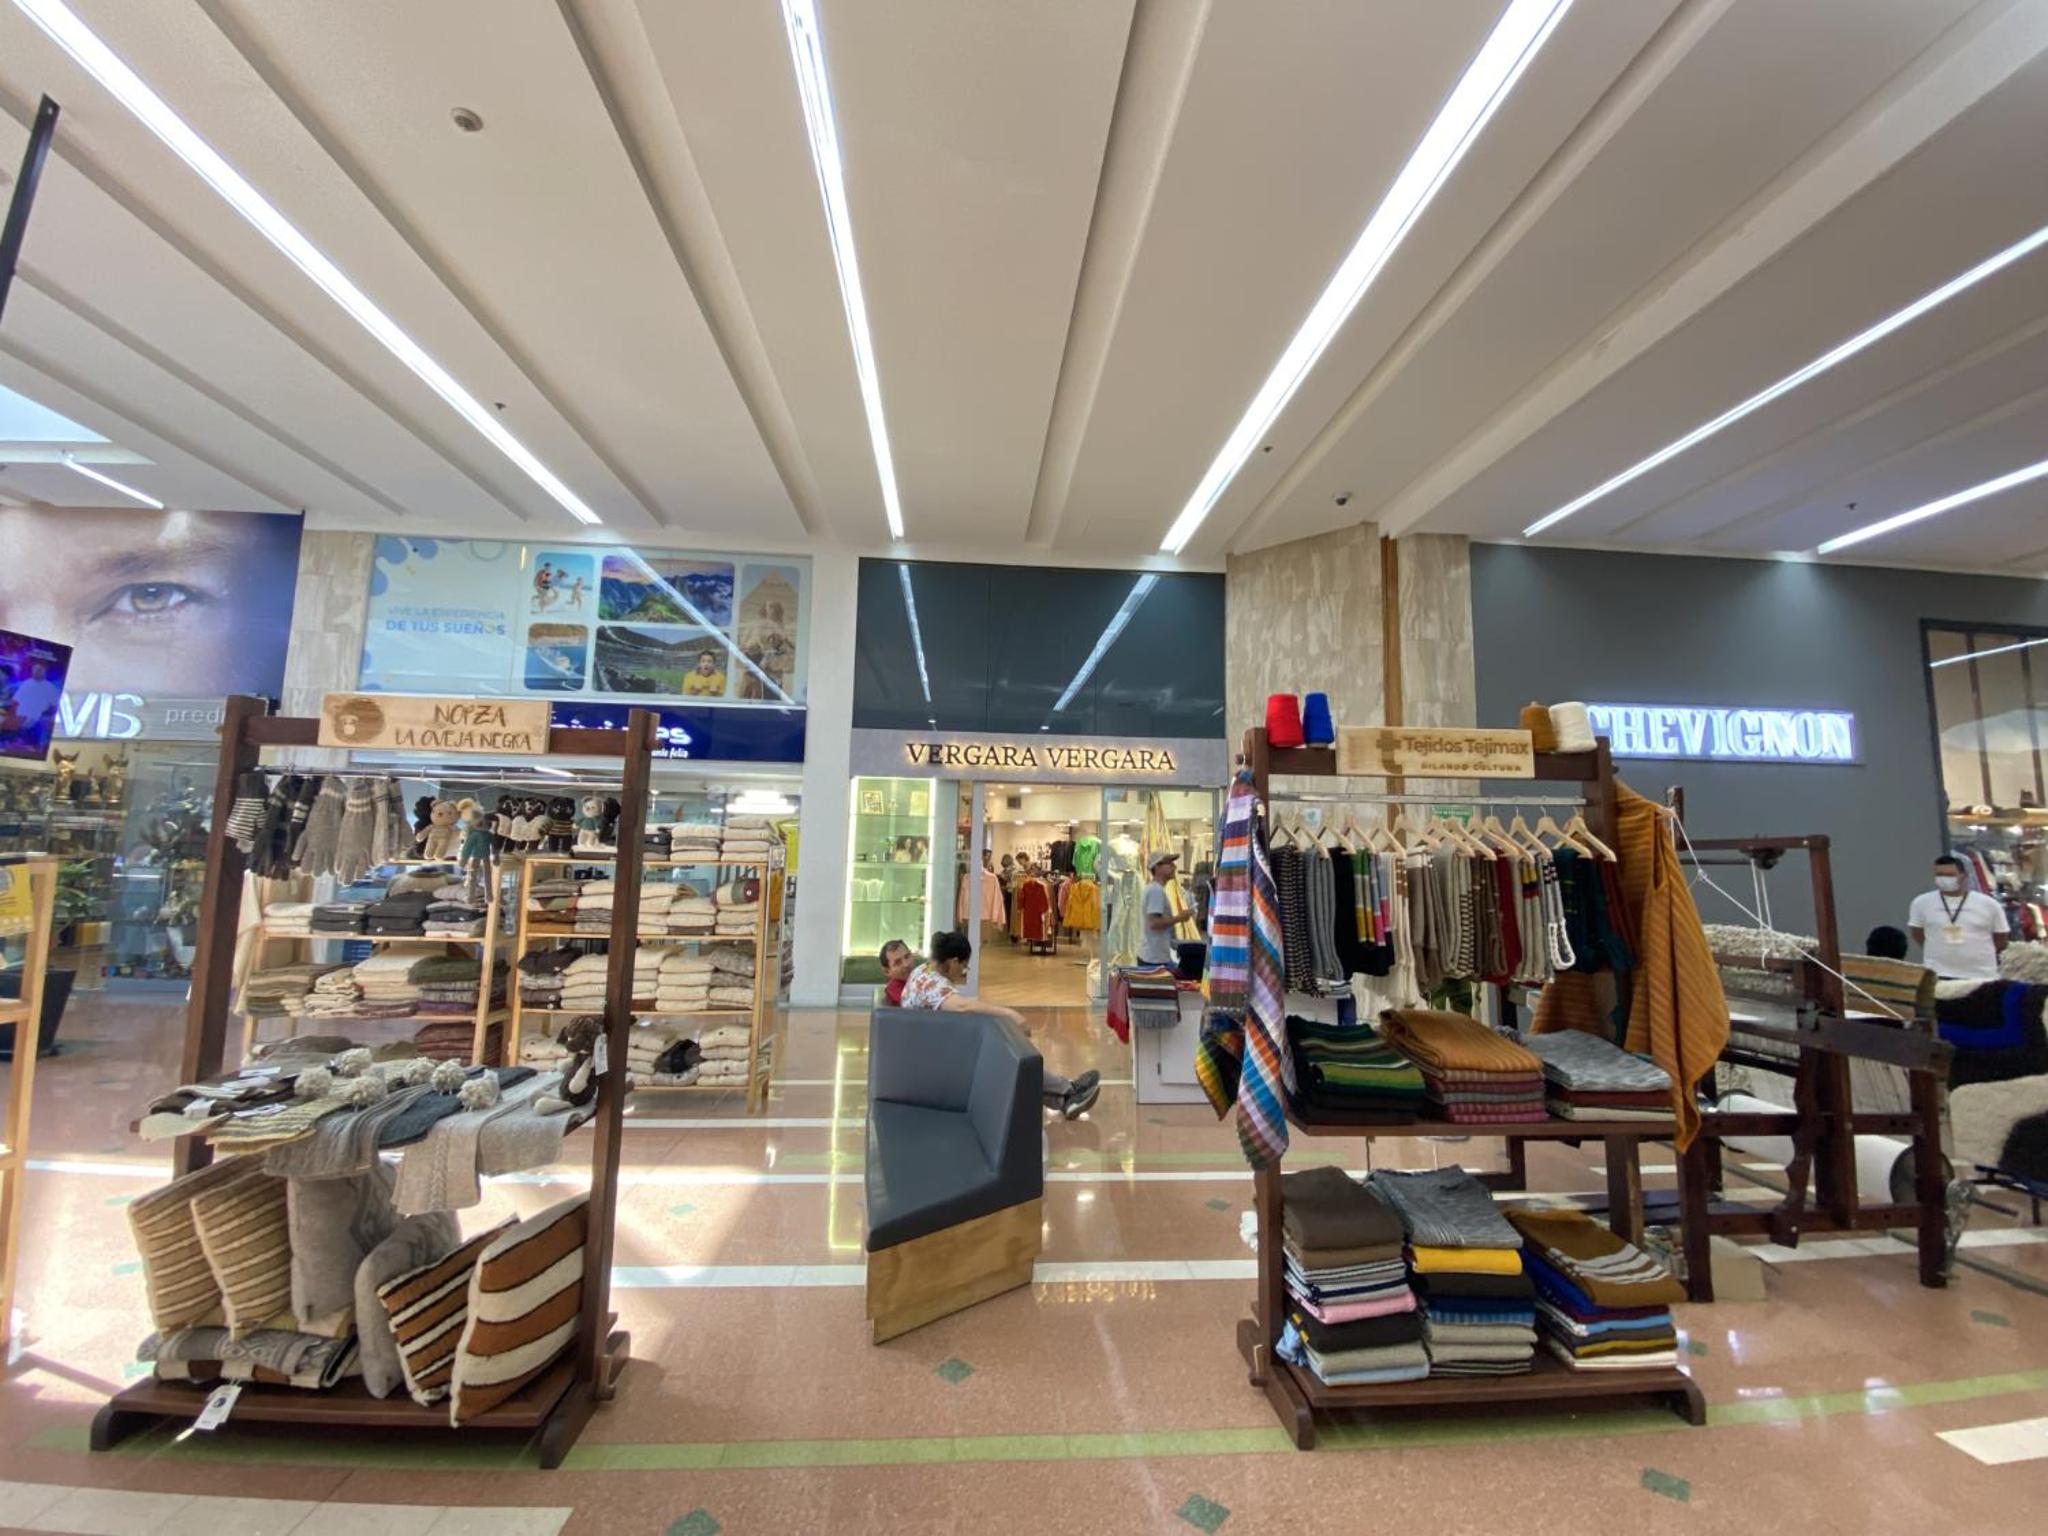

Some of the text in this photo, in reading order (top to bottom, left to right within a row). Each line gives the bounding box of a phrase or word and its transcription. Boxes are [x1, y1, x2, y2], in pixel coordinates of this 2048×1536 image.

[386, 620, 407, 631] DE
[411, 621, 439, 633] TUS
[55, 692, 145, 738] VIS
[395, 728, 415, 746] LA
[421, 728, 473, 749] OVEJA
[1586, 705, 1853, 759] CHEVIGNON
[907, 743, 1176, 771] VERGARA VERGARA
[1403, 737, 1529, 758] Tejidos Tejimax
